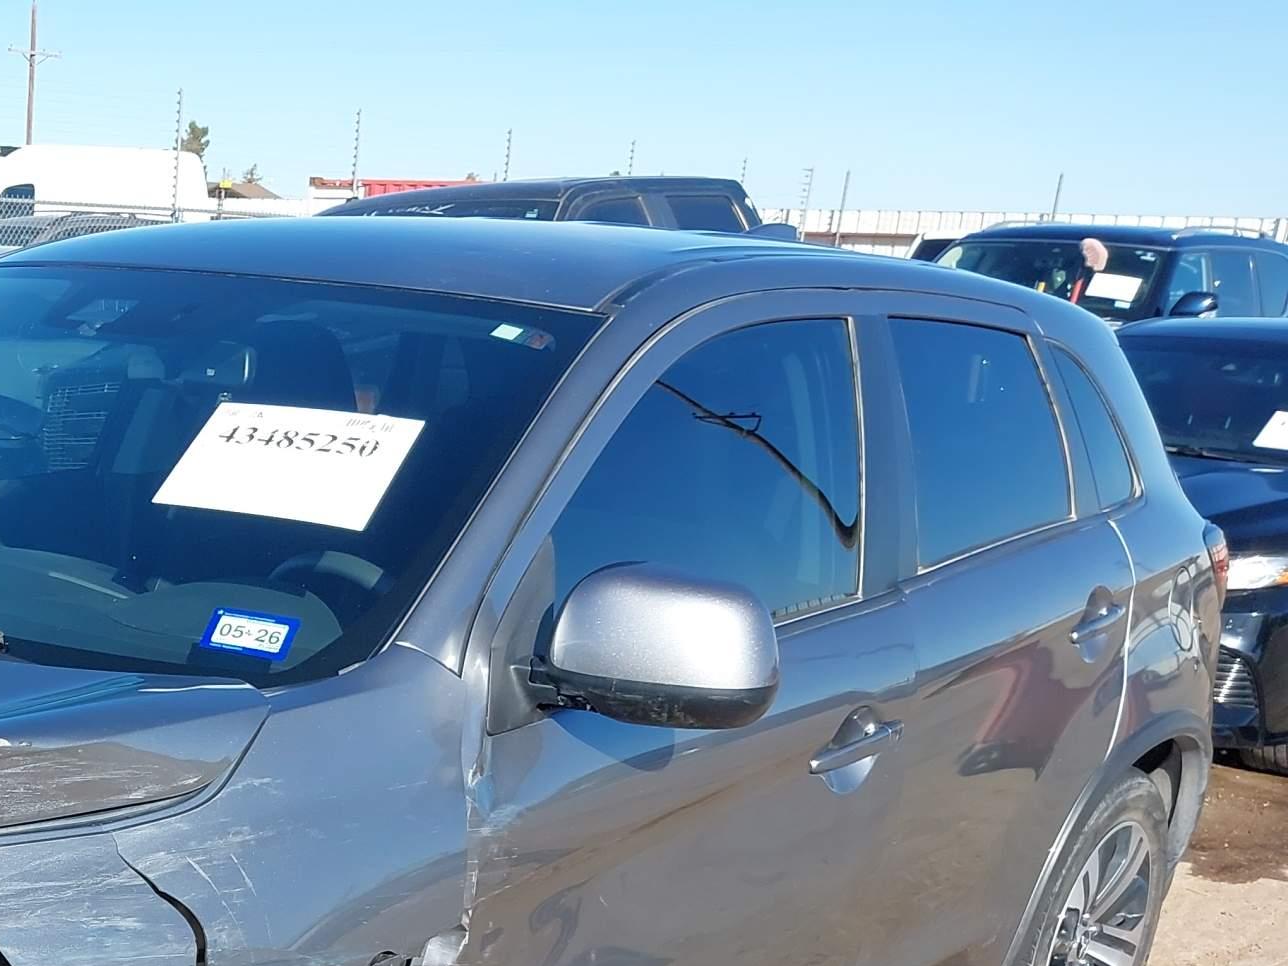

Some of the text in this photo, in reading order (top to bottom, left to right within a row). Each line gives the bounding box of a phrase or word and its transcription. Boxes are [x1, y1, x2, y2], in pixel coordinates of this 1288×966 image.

[218, 424, 381, 458] 43485250
[219, 622, 246, 640] 05
[253, 628, 282, 645] 26
